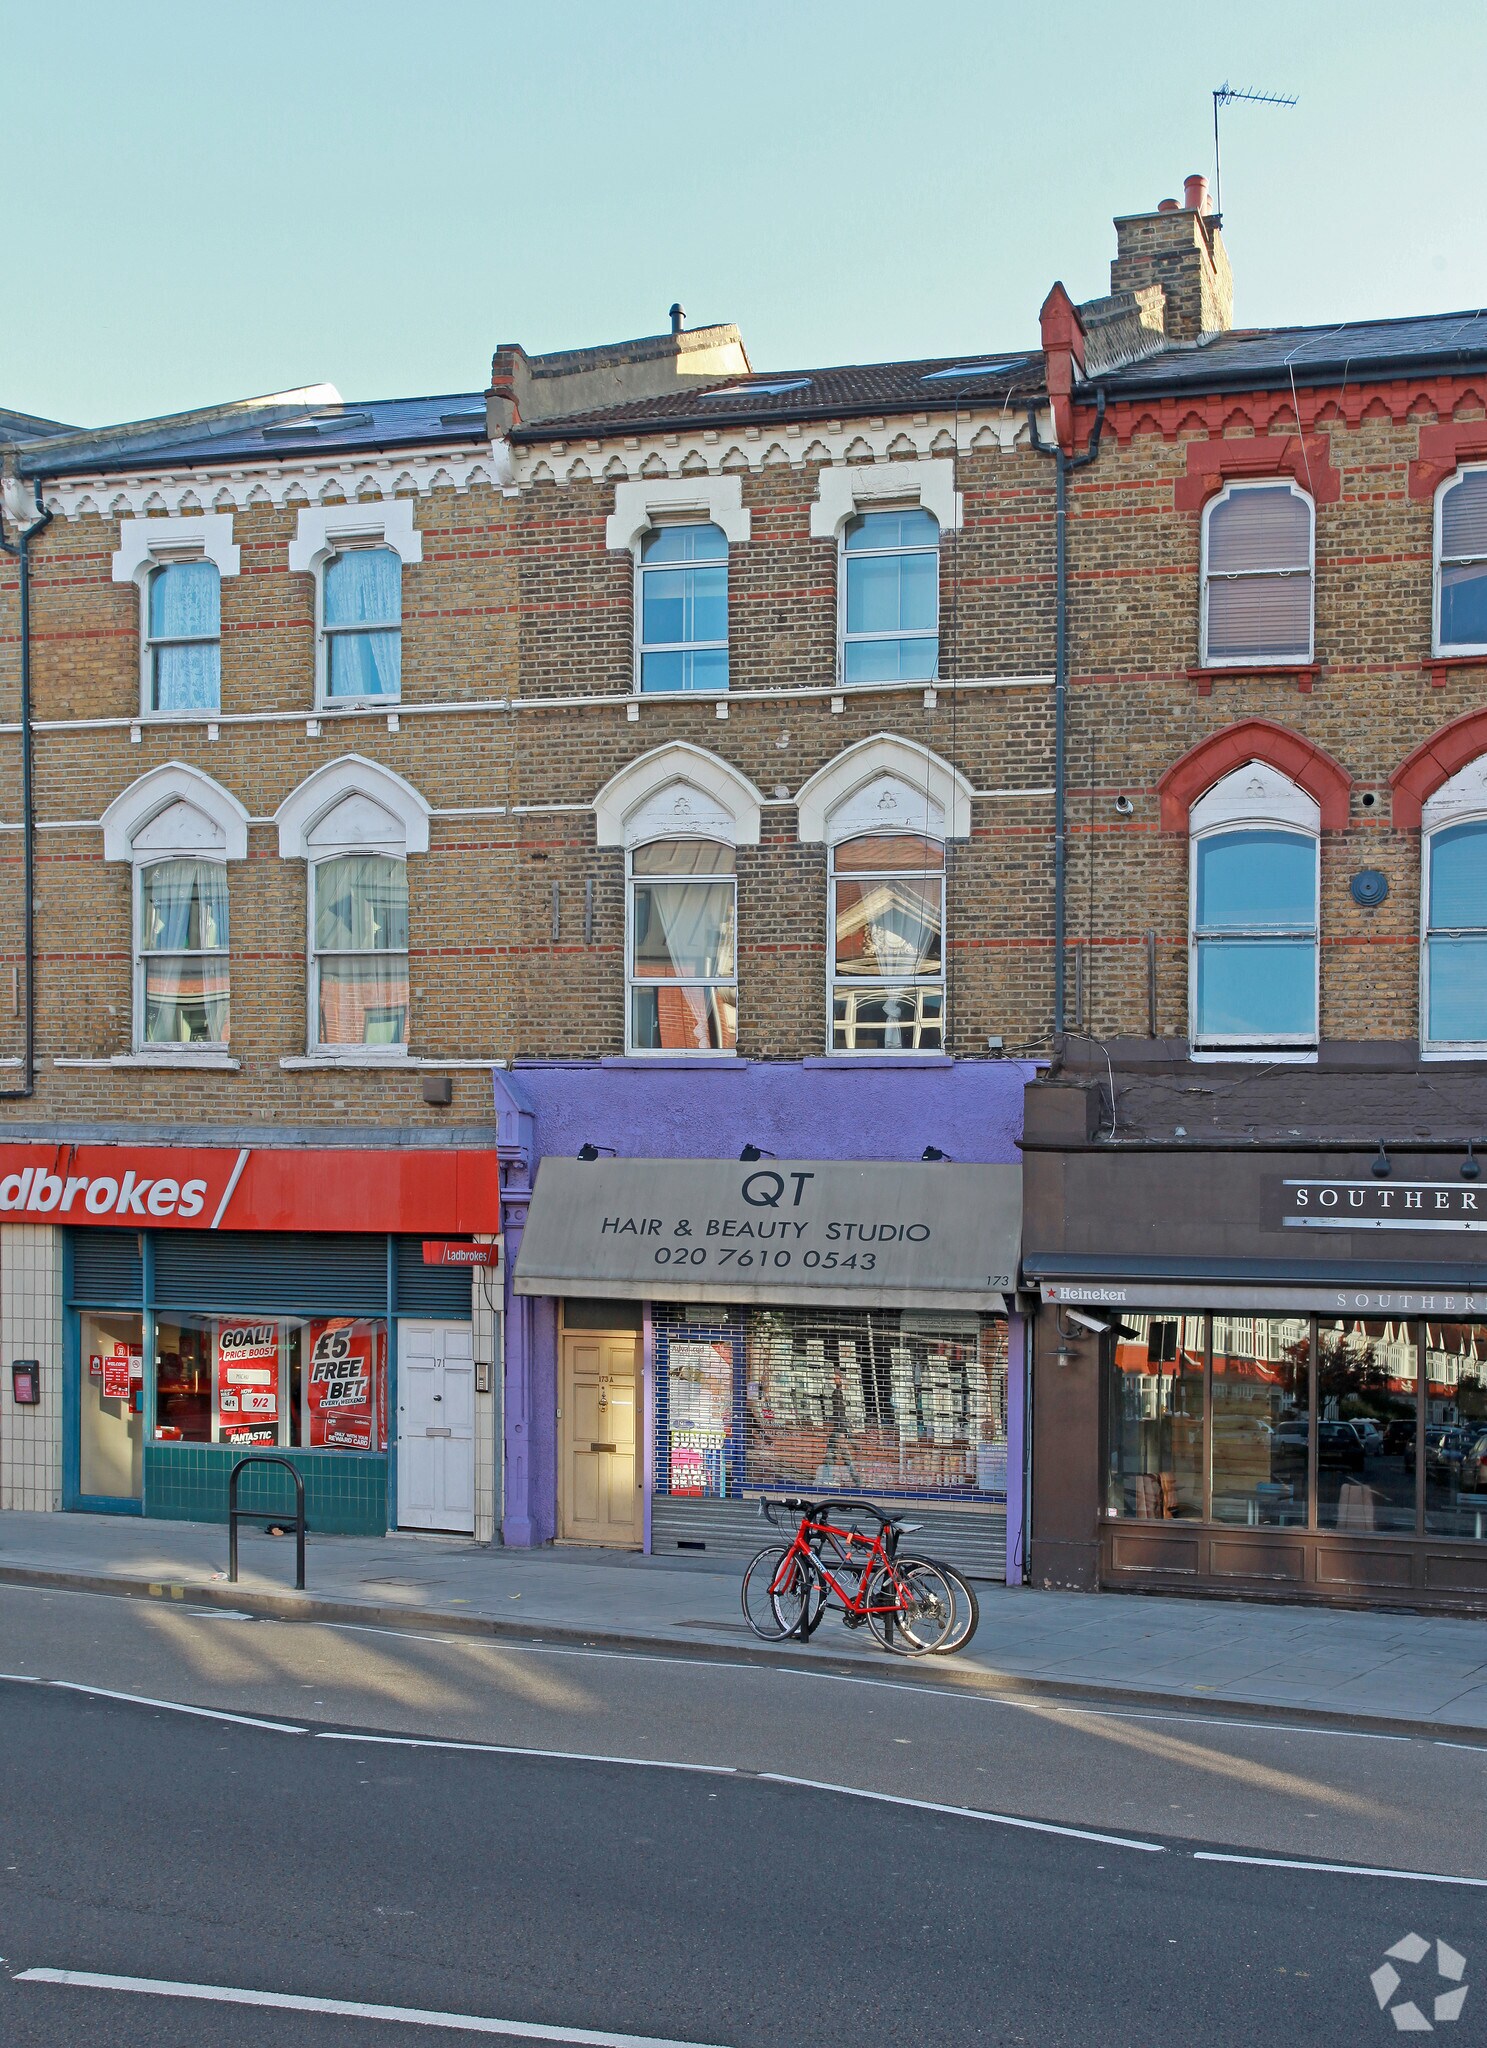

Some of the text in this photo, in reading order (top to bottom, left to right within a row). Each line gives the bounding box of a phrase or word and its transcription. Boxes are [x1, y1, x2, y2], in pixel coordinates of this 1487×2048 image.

[0, 1167, 208, 1217] dbrokes
[741, 1170, 815, 1208] QT
[1296, 1188, 1479, 1210] SOUTHER
[601, 1217, 931, 1242] HAIR & BEAUTY STUDIO
[447, 1250, 487, 1262] Ladbrokes
[654, 1247, 877, 1270] 020 7610 0543
[986, 1275, 1010, 1287] 173
[1059, 1287, 1126, 1301] Heineken
[1337, 1293, 1487, 1310] SOUTHER
[222, 1327, 272, 1348] GOAL!
[315, 1330, 350, 1360] £5
[225, 1346, 275, 1359] PRICE BOOST
[313, 1359, 362, 1380] FREE
[434, 1358, 445, 1368] 171
[330, 1379, 365, 1399] BET
[252, 1397, 269, 1408] 9/2
[230, 1431, 272, 1442] FANTASTIC
[328, 1434, 352, 1444] REWARD
